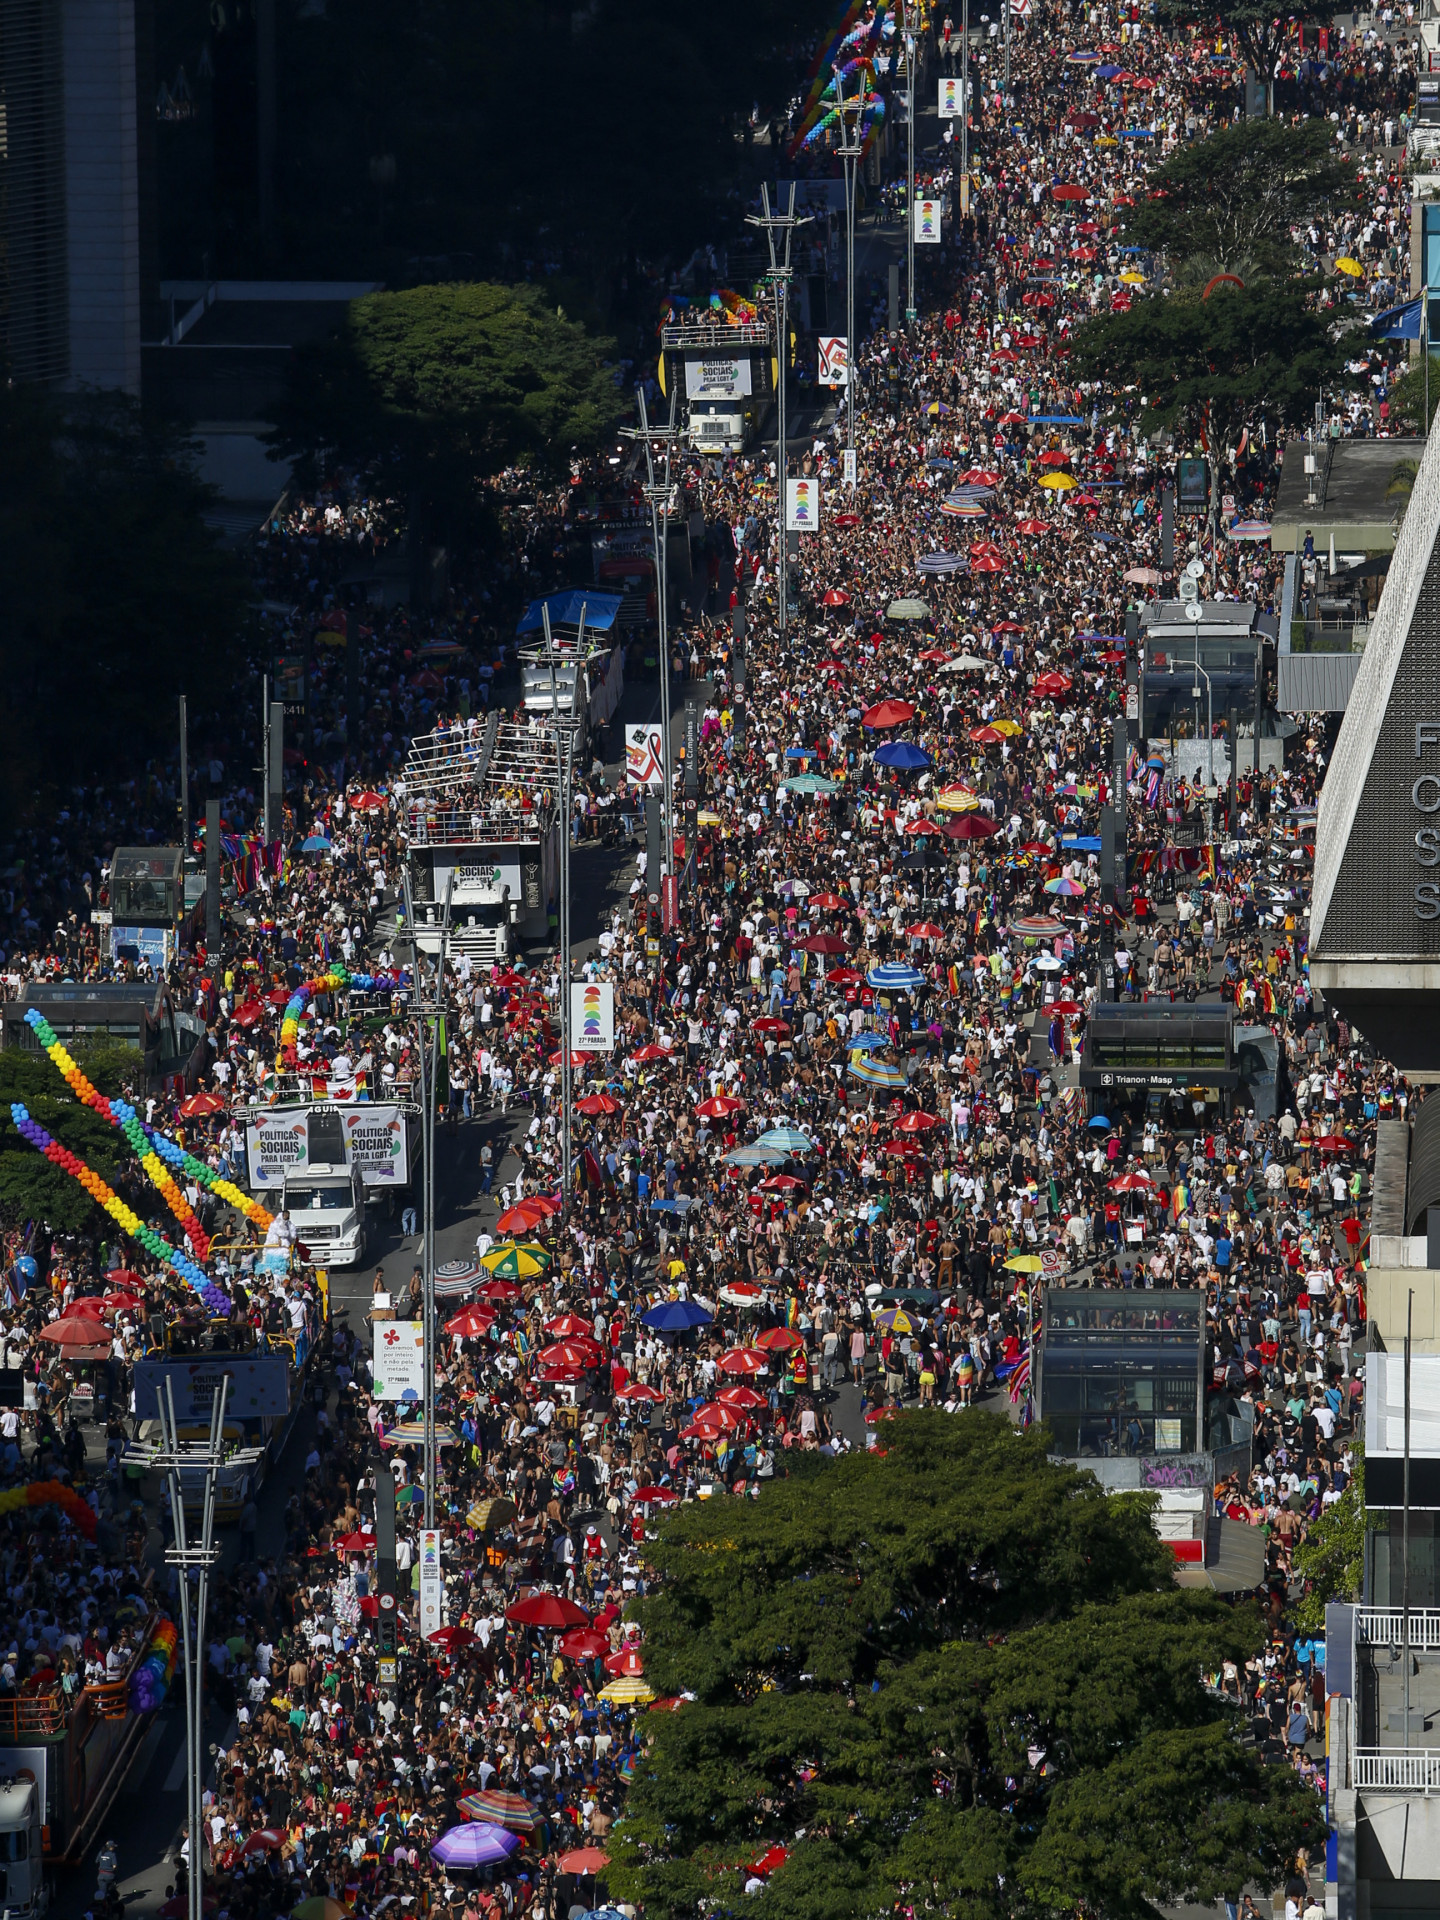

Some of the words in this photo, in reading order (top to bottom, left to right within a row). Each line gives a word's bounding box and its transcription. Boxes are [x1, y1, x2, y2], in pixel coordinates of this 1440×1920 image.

[1180, 505, 1202, 513] 13:41
[460, 866, 494, 877] SOCIAIS
[1150, 1076, 1172, 1084] Masp
[260, 1129, 299, 1140] POLÍTICAS
[351, 1127, 393, 1138] POLÍTICAS
[260, 1141, 299, 1153] SOCIAIS
[351, 1137, 393, 1151] SOCIAIS
[279, 1155, 300, 1163] LGBT+
[352, 1152, 370, 1161] PARA
[372, 1151, 394, 1160] LGBT+
